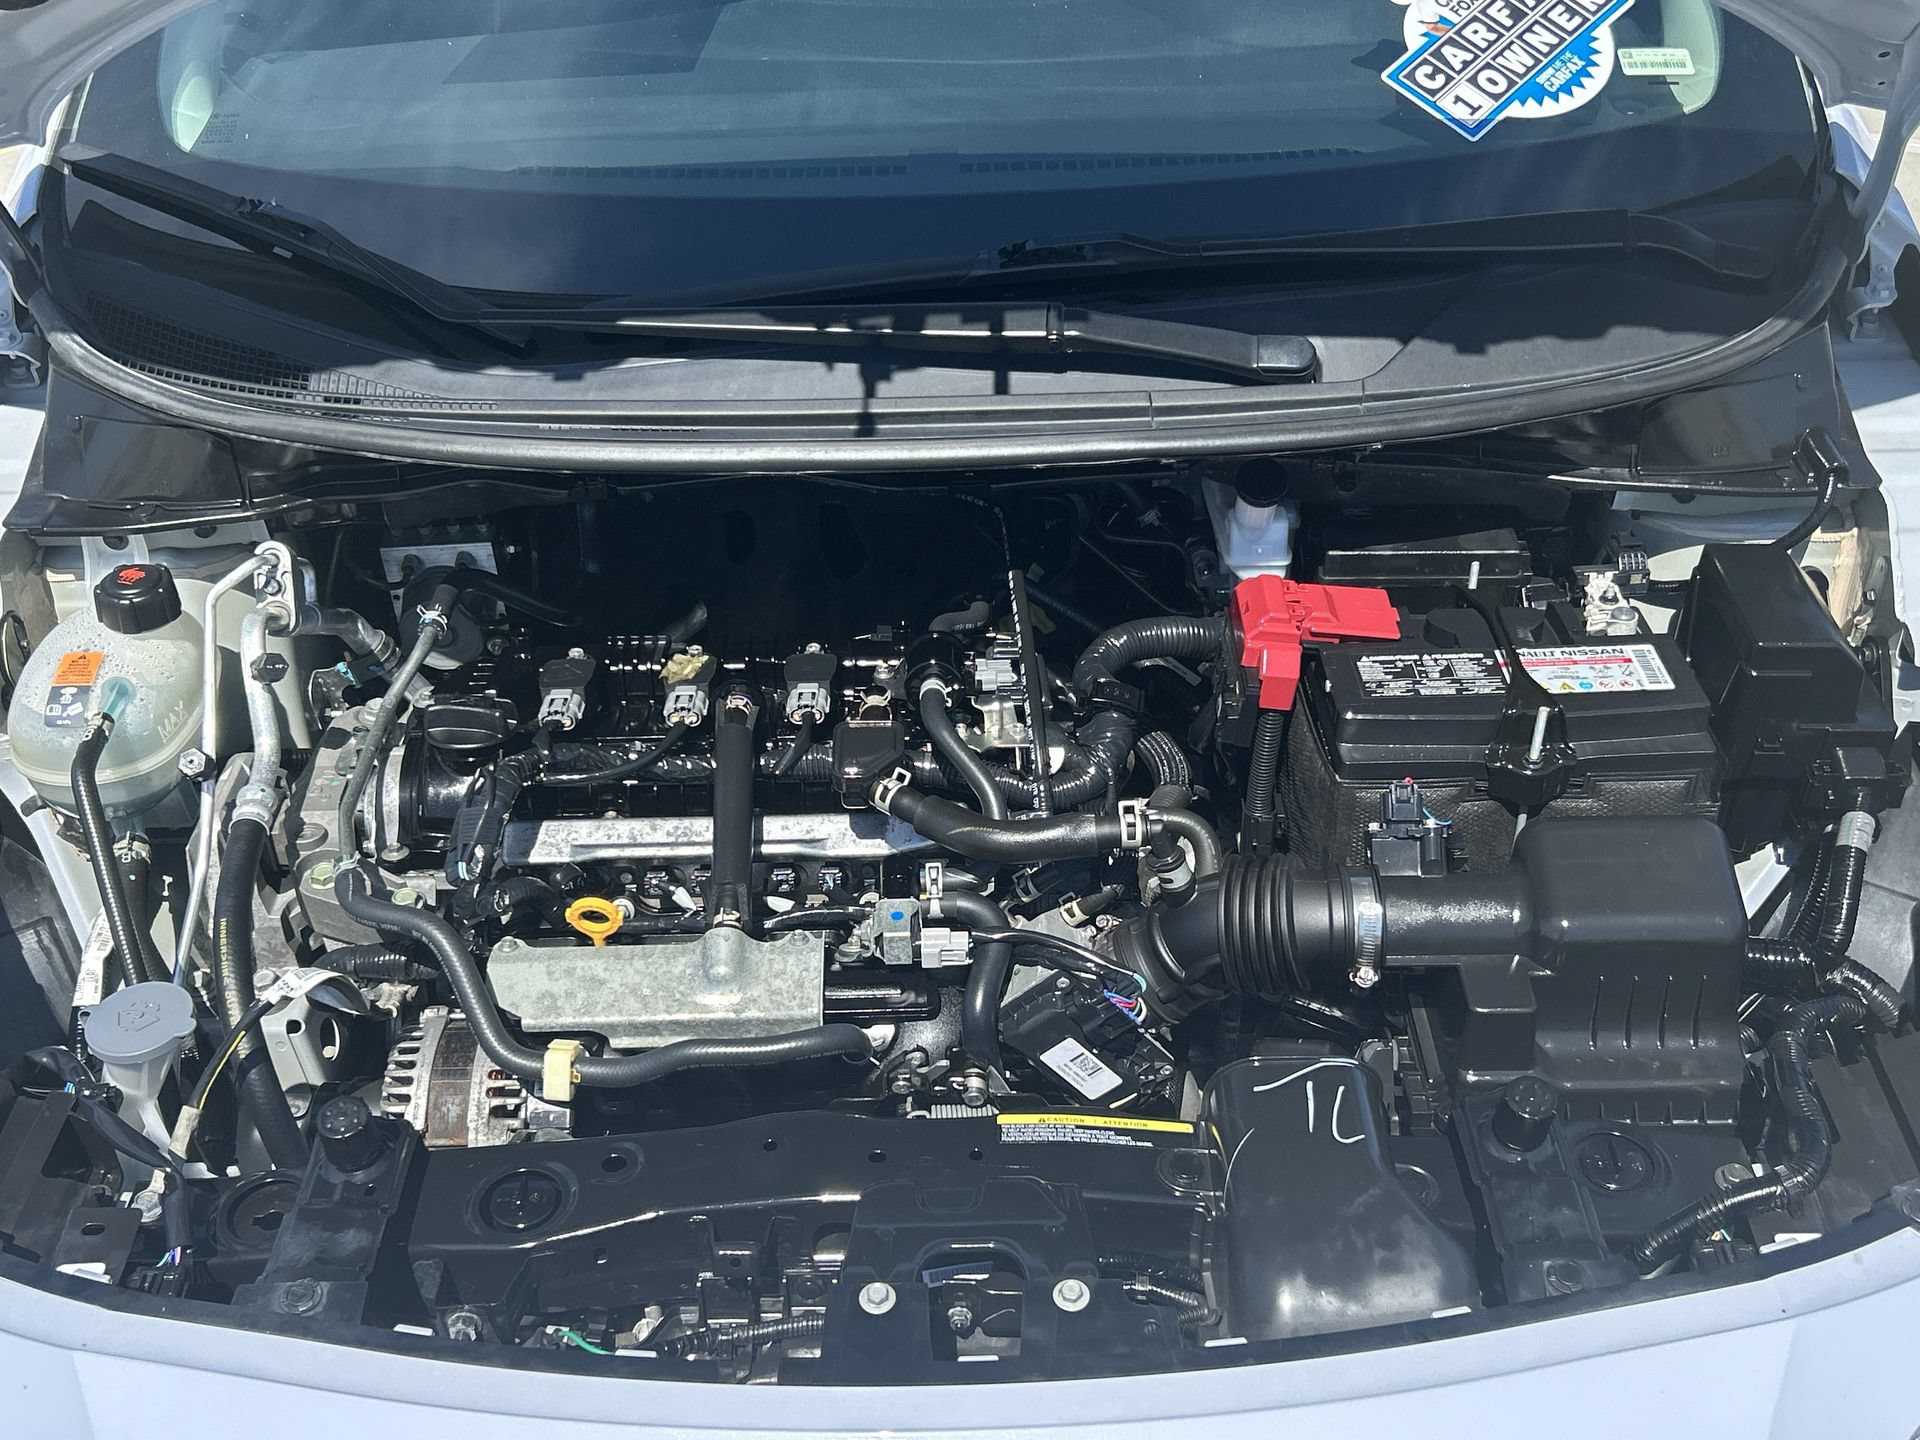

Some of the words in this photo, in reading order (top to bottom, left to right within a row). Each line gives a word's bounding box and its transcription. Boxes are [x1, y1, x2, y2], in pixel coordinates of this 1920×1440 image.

[1543, 55, 1586, 92] CARFAX
[1452, 91, 1484, 117] 1
[1560, 647, 1625, 656] NISSAN
[157, 700, 190, 743] MAX
[1103, 1120, 1149, 1128] ATTENTION
